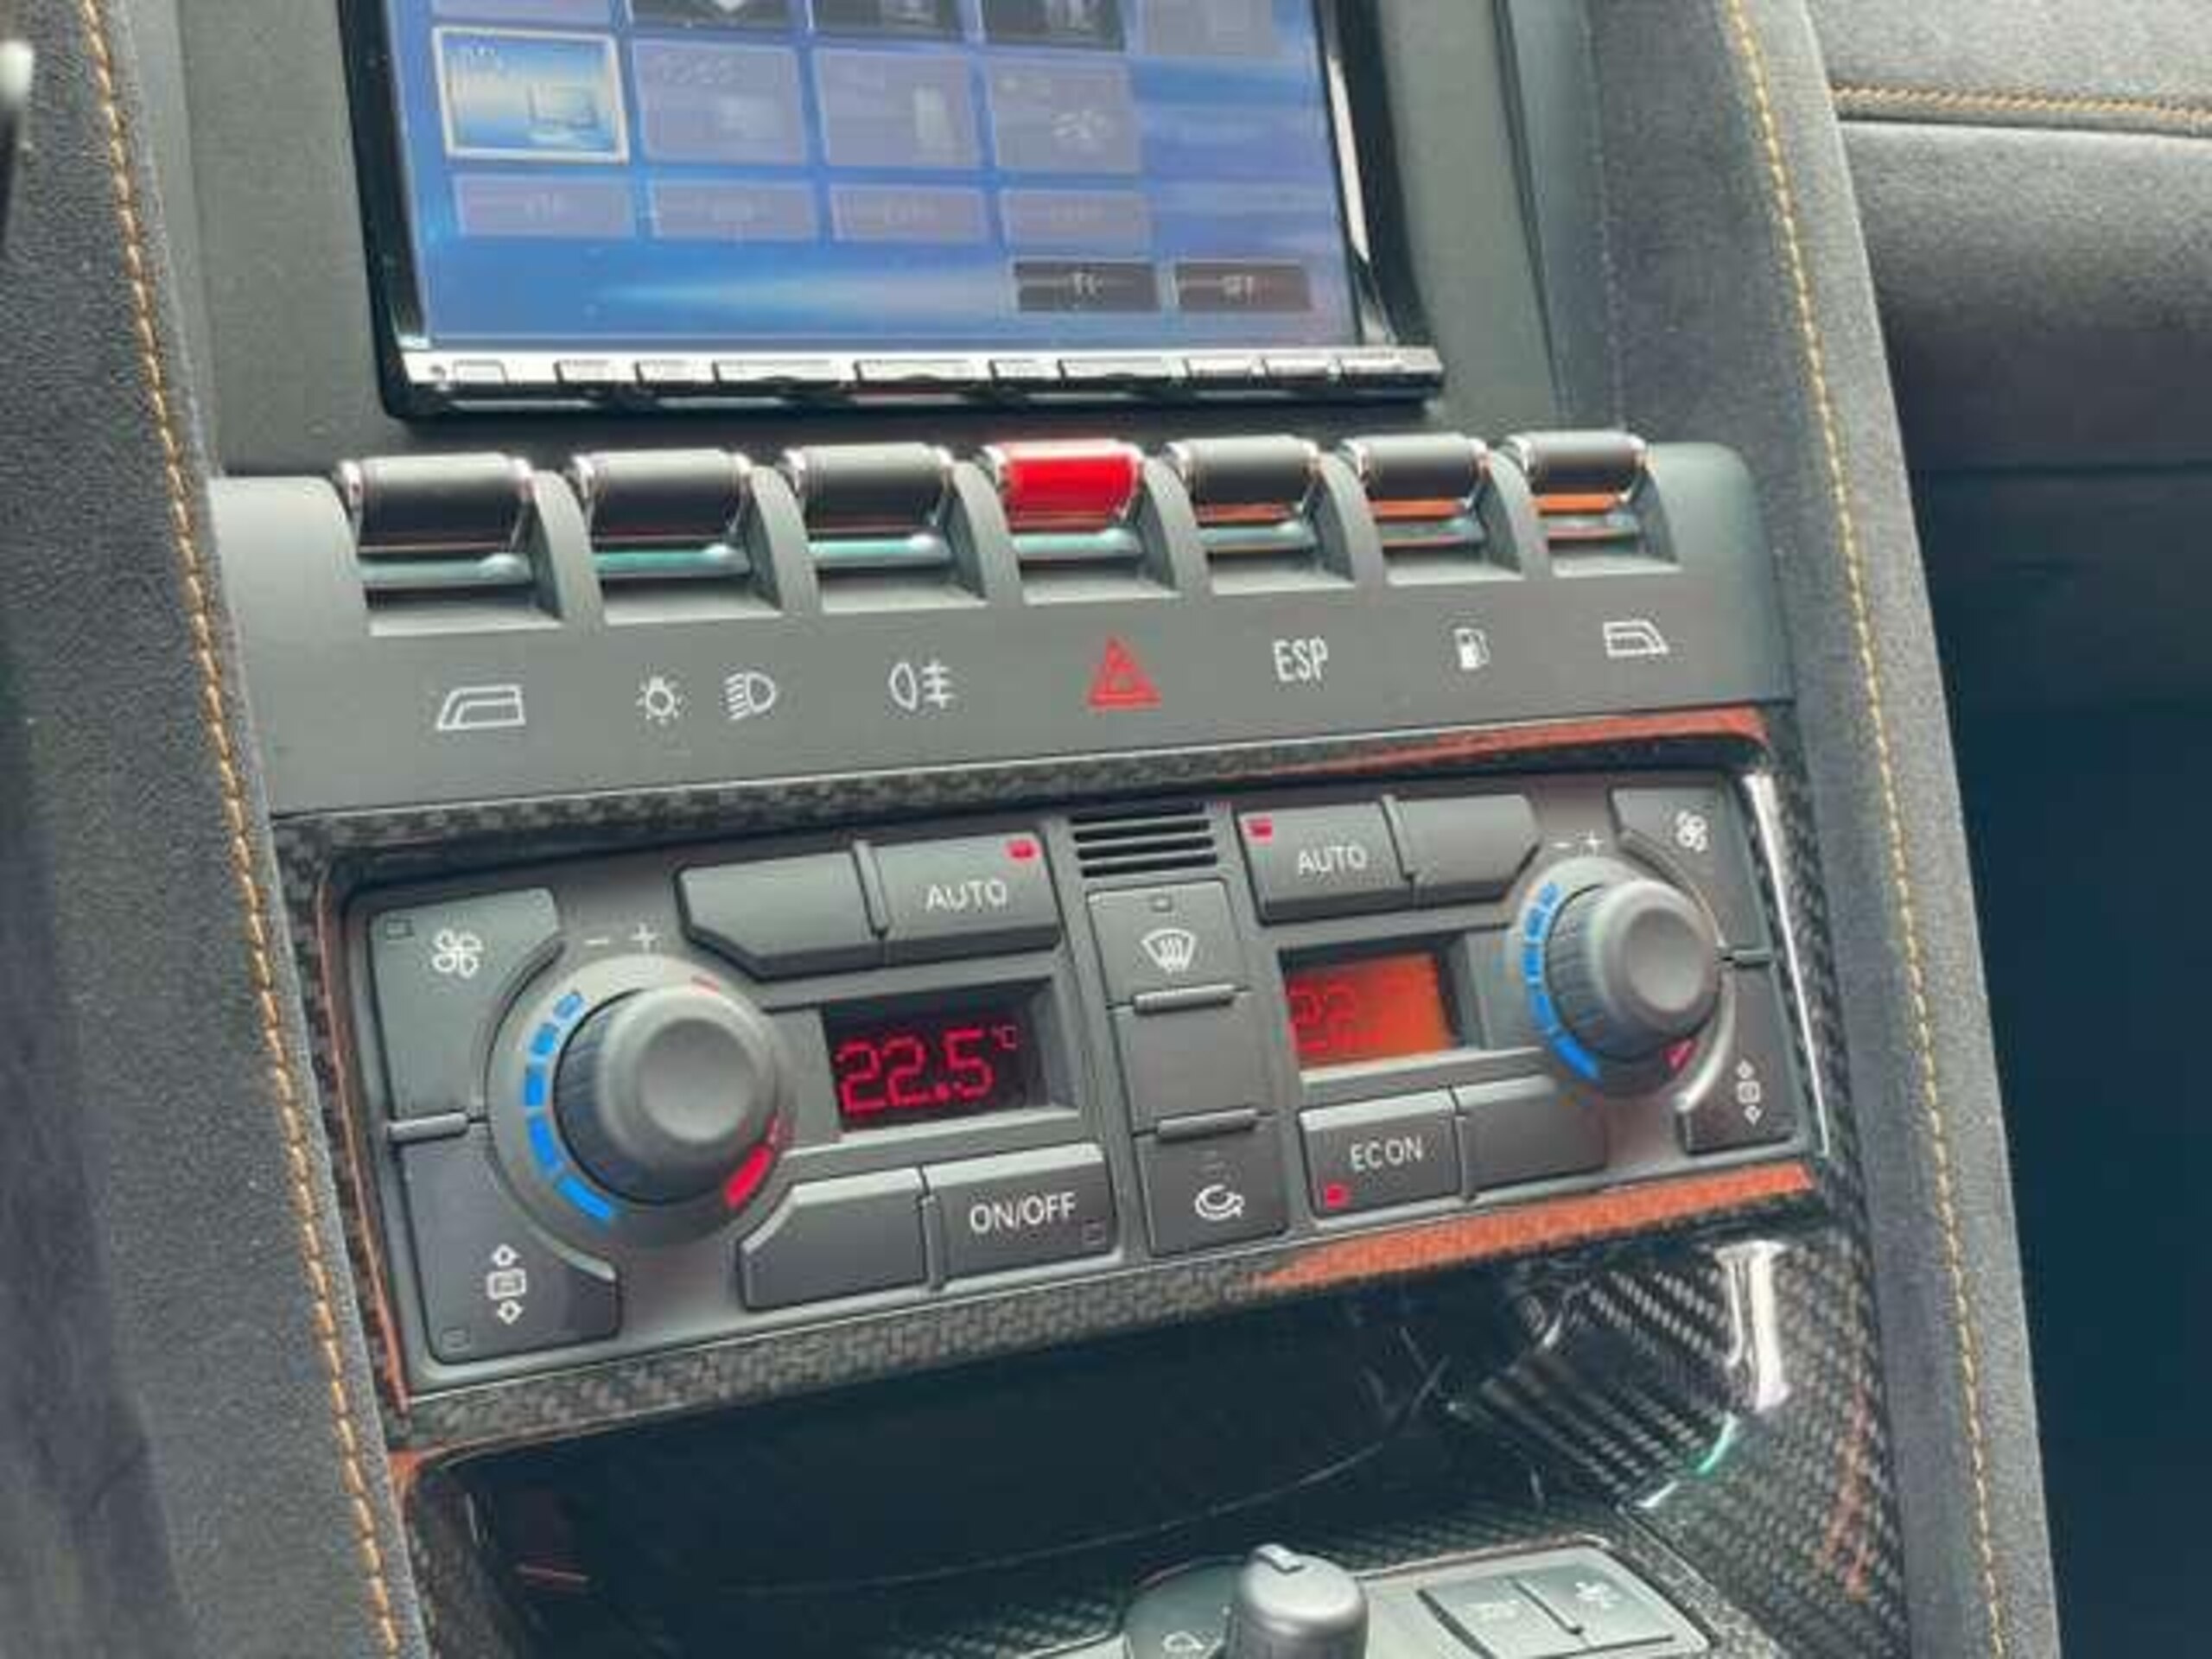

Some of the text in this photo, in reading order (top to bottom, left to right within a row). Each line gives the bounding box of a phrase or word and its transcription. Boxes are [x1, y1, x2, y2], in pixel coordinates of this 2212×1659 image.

[1273, 637, 1328, 682] ESP
[1298, 845, 1365, 875] AUTO
[925, 878, 1007, 912] AUTO
[1350, 1135, 1423, 1172] ECON
[969, 1192, 1077, 1234] ON/OFF
